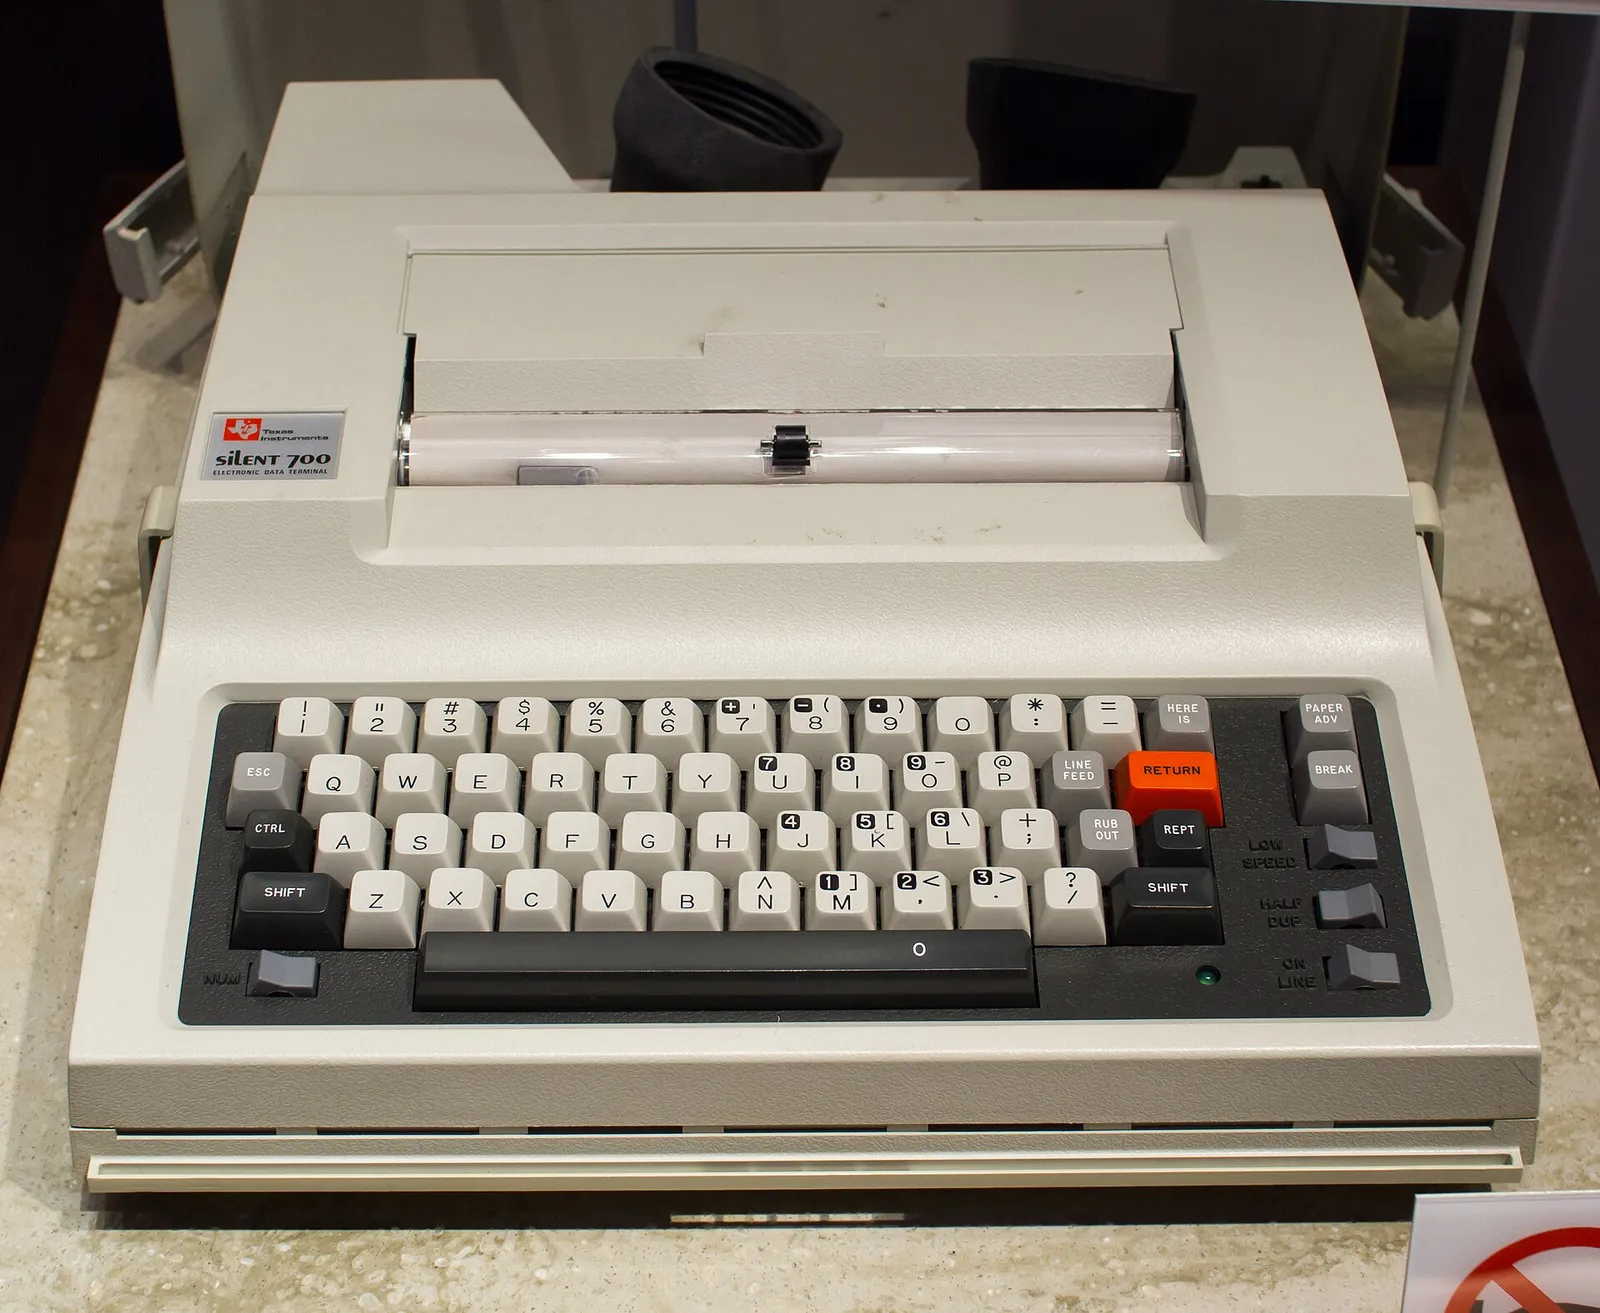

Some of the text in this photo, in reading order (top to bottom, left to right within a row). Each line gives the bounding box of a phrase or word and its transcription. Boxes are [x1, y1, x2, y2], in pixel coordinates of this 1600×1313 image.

[287, 454, 331, 468] 700
[302, 700, 308, 717] !
[443, 701, 460, 715] #
[518, 699, 531, 716] $
[588, 701, 605, 716] %
[660, 700, 677, 717] &
[823, 696, 830, 713] (
[898, 698, 904, 714] )
[1100, 701, 1117, 711] =
[1167, 703, 1199, 713] HERE
[1305, 702, 1344, 713] PAPER
[369, 717, 384, 733] 2
[442, 718, 458, 733] 3
[515, 717, 531, 732] 4
[588, 718, 603, 734] 5
[660, 718, 675, 733] 6
[735, 717, 750, 732] 7
[808, 715, 823, 730] 8
[883, 716, 898, 731] 9
[1033, 718, 1039, 726] :
[1178, 715, 1191, 724] IS
[1314, 714, 1338, 724] ADV
[762, 756, 775, 770] 7
[839, 757, 852, 770] 8
[910, 756, 924, 770] 9
[993, 754, 1013, 770] @
[1064, 759, 1092, 770] LINE
[1314, 764, 1353, 775] BREAK
[246, 767, 271, 777] ESC
[1062, 770, 1095, 781] FEED
[1143, 765, 1201, 776] RETURN
[325, 776, 342, 792] Q
[398, 775, 418, 789] W
[473, 774, 488, 790] E
[549, 773, 564, 788] R
[622, 775, 638, 790] T
[697, 774, 713, 789] Y
[772, 774, 788, 790] U
[921, 773, 938, 789] O
[997, 772, 1012, 787] P
[784, 813, 799, 829] 4
[859, 813, 895, 830] 5 [
[934, 811, 971, 827] 6 \
[1018, 812, 1037, 828] +
[1094, 818, 1119, 829] RUB
[254, 823, 286, 833] CTRL
[1095, 830, 1120, 841] OUT
[1163, 824, 1195, 835] REPT
[335, 834, 351, 850] A
[412, 835, 428, 851] S
[491, 834, 506, 850] D
[565, 833, 580, 849] F
[640, 833, 655, 849] G
[715, 833, 731, 849] H
[796, 833, 809, 848] J
[871, 832, 886, 848] K
[945, 830, 961, 846] L
[1026, 833, 1032, 845] ;
[1249, 839, 1283, 850] LOW
[1242, 857, 1297, 868] SPEED
[825, 873, 858, 892] 1 ]
[901, 874, 941, 889] 2 <
[975, 870, 1017, 886] 3 >
[1065, 871, 1077, 888] ?
[264, 887, 306, 898] SHIFT
[1147, 882, 1189, 893] SHIFT
[368, 893, 384, 909] Z
[446, 890, 463, 906] X
[524, 892, 539, 908] C
[601, 893, 617, 909] V
[680, 894, 695, 909] B
[758, 894, 773, 910] N
[832, 894, 851, 911] M
[1067, 890, 1078, 904] /
[1260, 899, 1302, 909] HALF
[1268, 917, 1301, 927] DUP
[1283, 958, 1306, 969] ON
[202, 973, 241, 985] NUM
[1278, 976, 1317, 989] LINE
